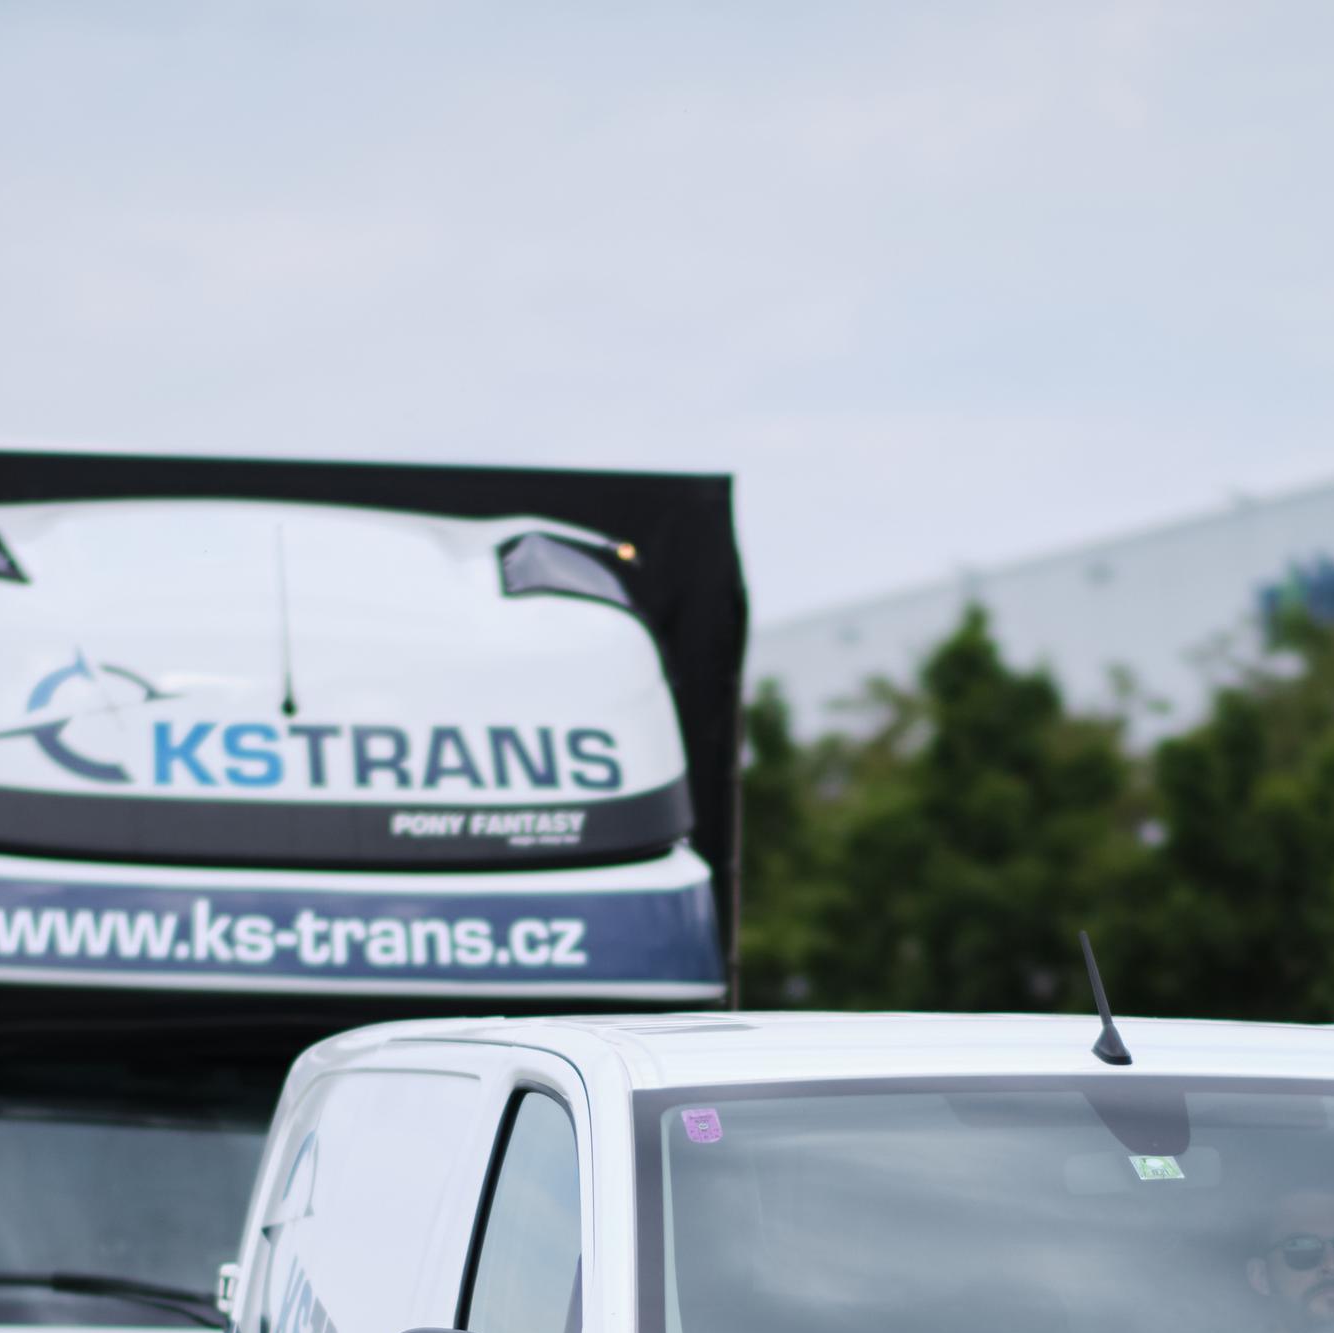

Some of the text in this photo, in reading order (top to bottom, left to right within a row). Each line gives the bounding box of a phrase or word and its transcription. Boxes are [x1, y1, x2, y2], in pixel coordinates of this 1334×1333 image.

[153, 720, 622, 791] KSTRANS
[392, 811, 585, 835] PONY FANTASY
